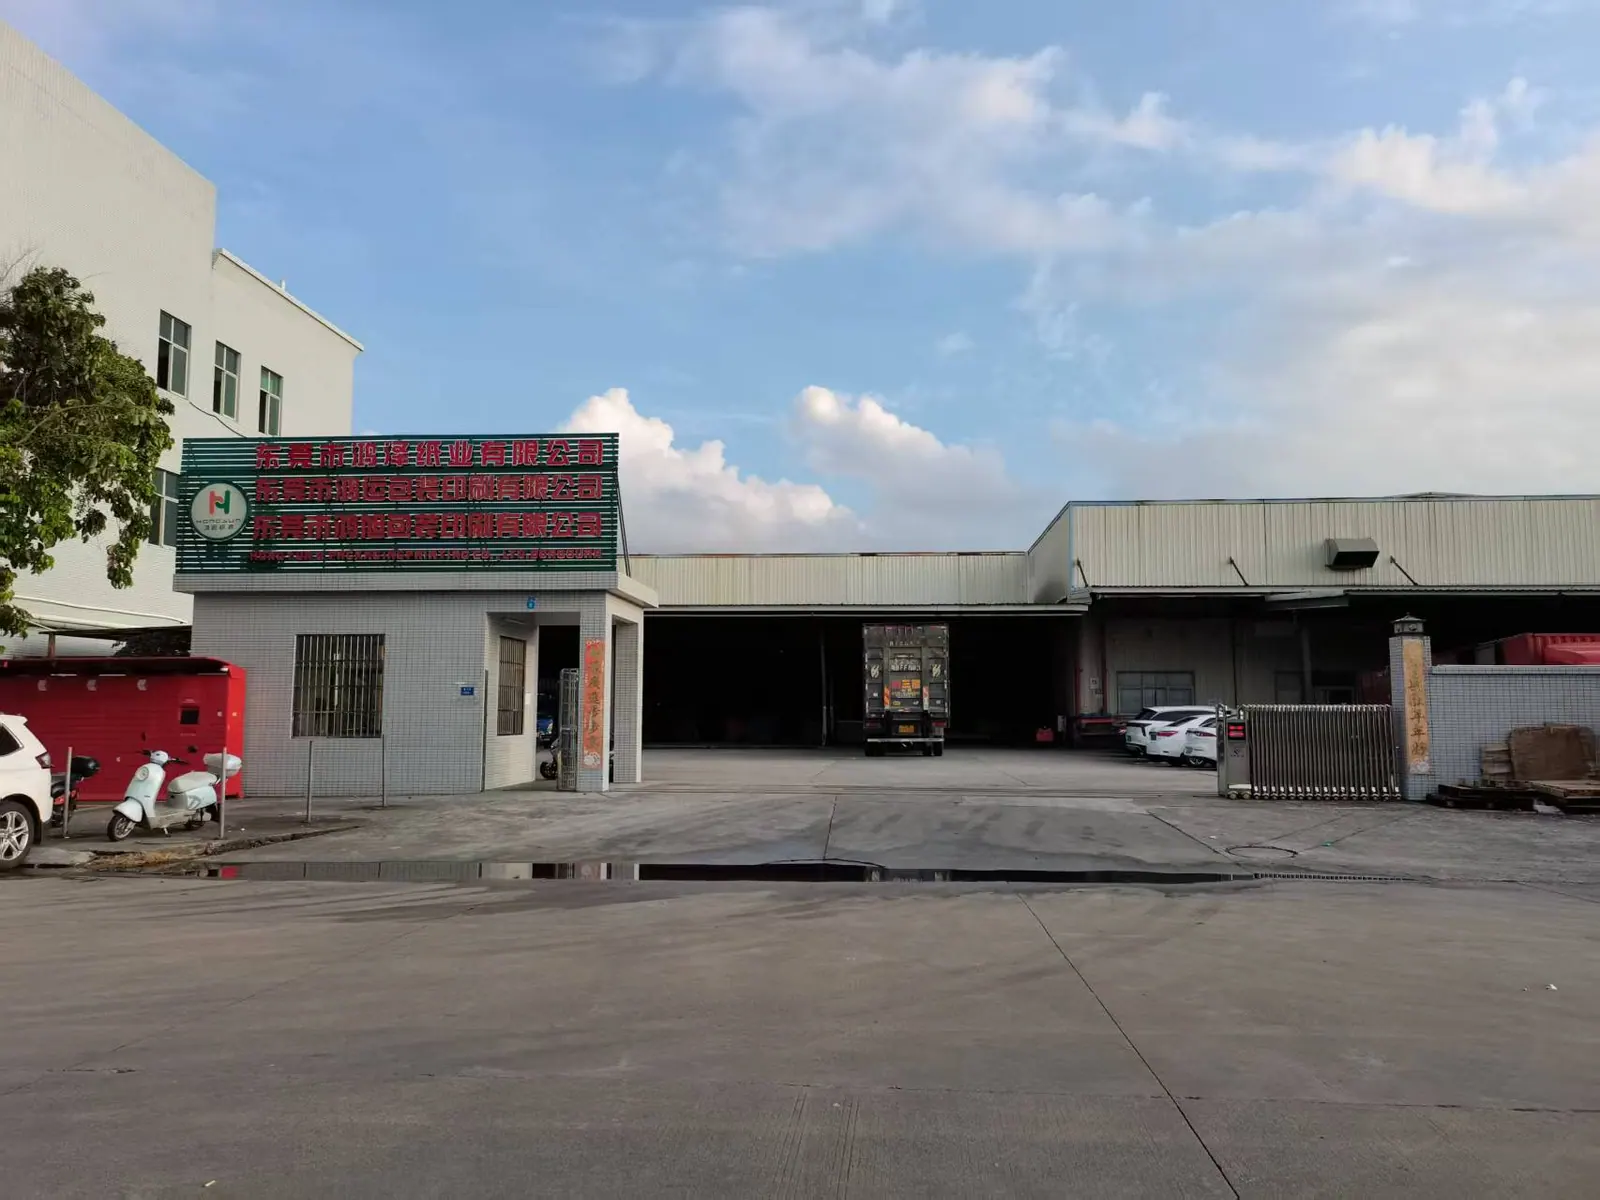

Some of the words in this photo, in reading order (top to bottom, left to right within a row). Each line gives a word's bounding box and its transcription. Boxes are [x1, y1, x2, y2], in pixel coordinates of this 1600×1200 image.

[256, 440, 603, 469] 东莞市鸿泽纸业有限公司
